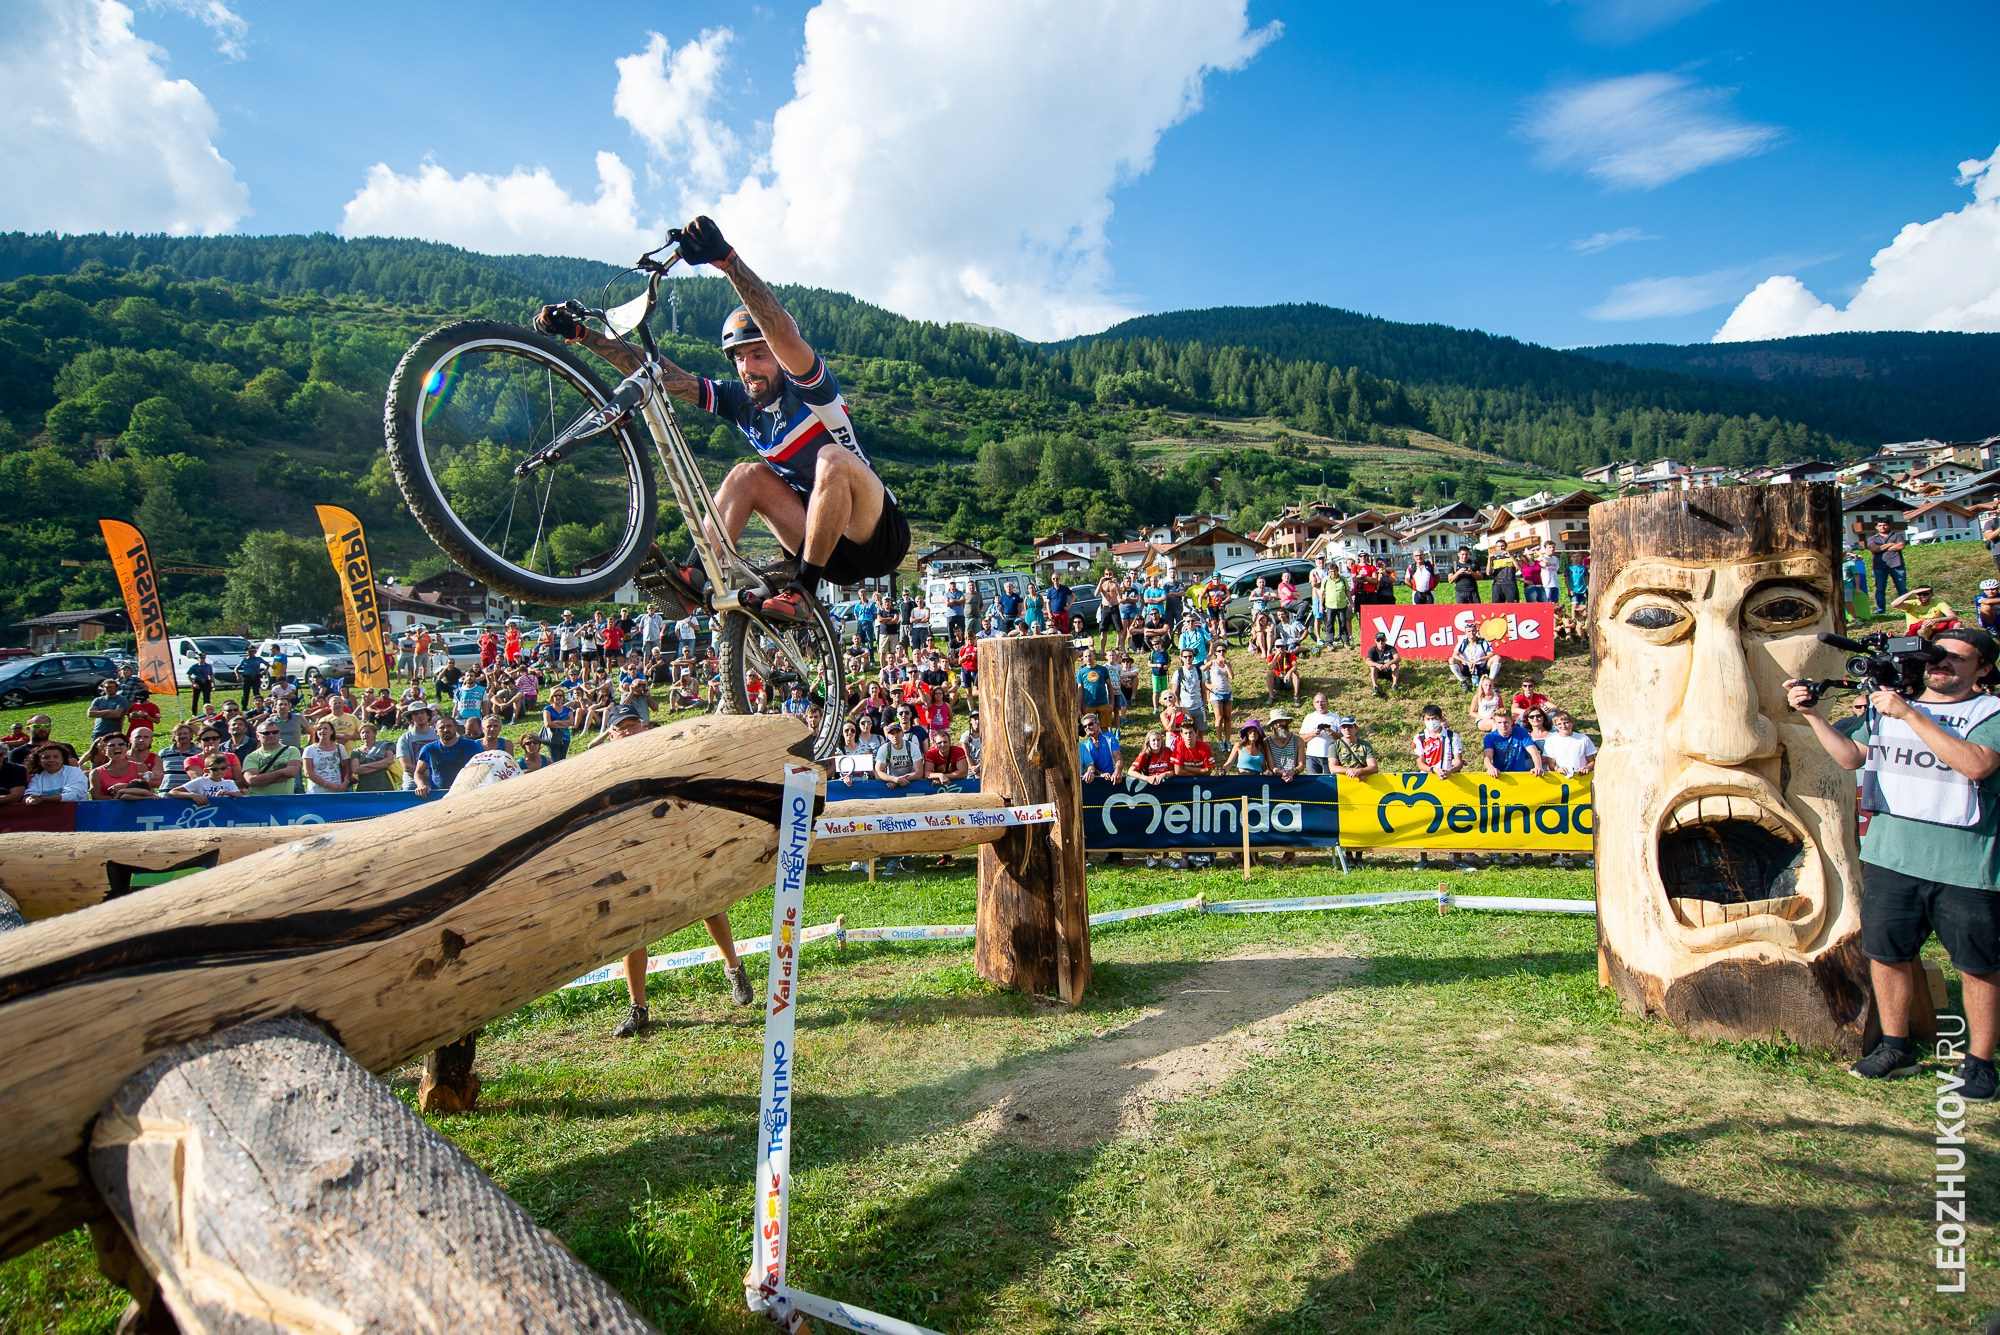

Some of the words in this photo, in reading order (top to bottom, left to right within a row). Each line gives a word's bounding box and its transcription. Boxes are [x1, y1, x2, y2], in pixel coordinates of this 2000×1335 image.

[1372, 614, 1427, 650] Val
[1429, 625, 1455, 648] di
[824, 821, 842, 835] Val
[876, 818, 917, 832] TRENTINO
[924, 815, 941, 827] Val
[968, 812, 1005, 826] TRENTINO
[1013, 809, 1031, 822] Val
[1102, 783, 1303, 835] Melinda
[782, 796, 810, 893] TRENTINO
[781, 961, 793, 976] di
[772, 977, 791, 1017] Val
[767, 1040, 789, 1159] TRENTINO
[770, 1239, 779, 1260] di
